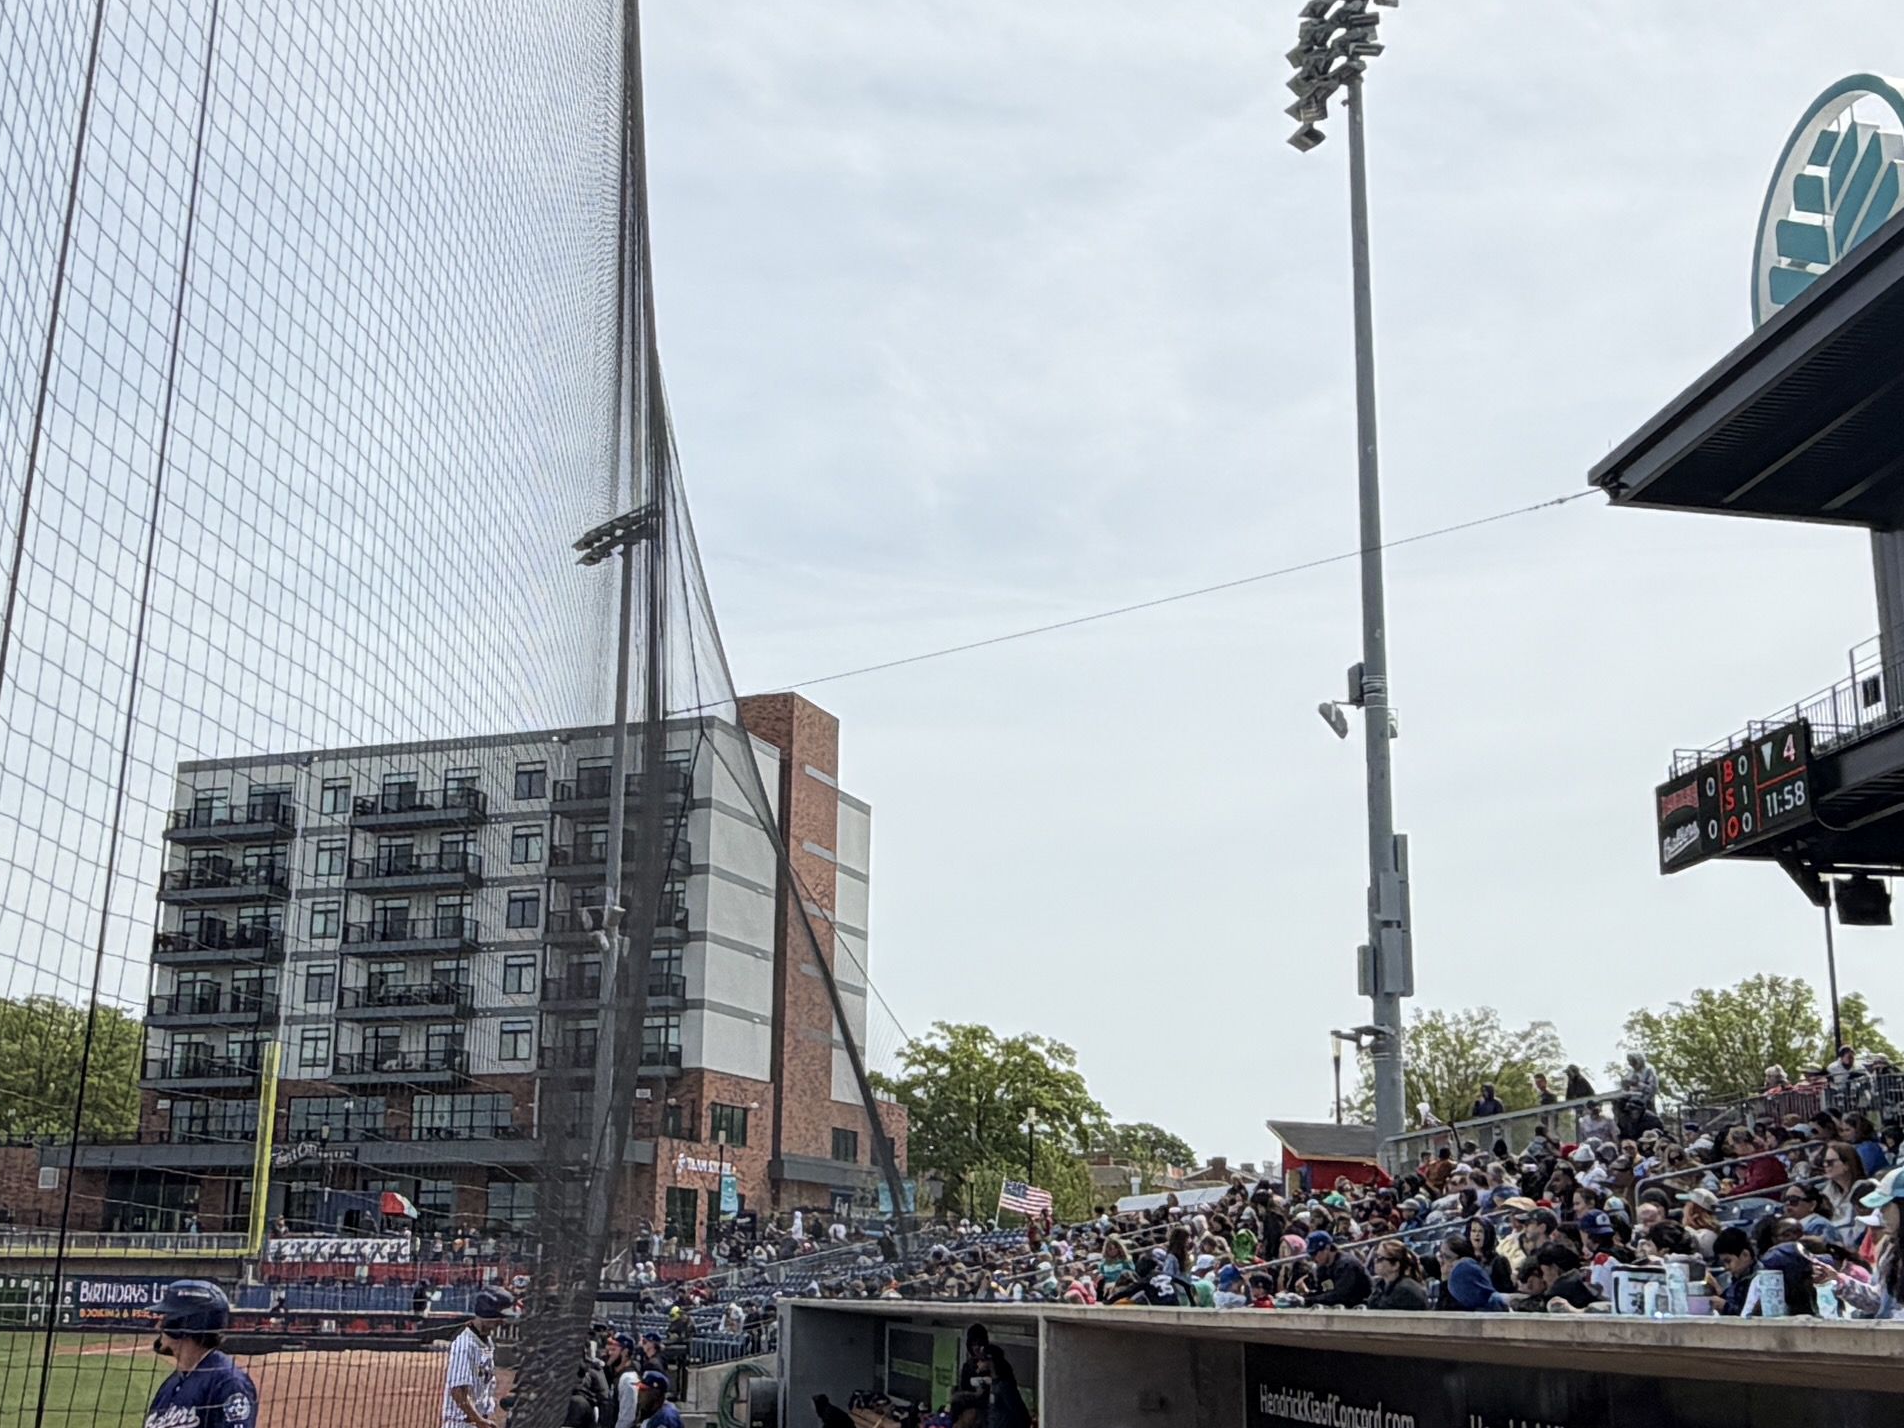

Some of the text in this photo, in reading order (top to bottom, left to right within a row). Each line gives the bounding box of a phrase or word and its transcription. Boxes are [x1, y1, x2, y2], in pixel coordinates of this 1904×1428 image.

[1782, 733, 1796, 763] 4
[1723, 755, 1748, 784] B 0
[1705, 776, 1716, 797] 0
[1725, 787, 1736, 812] S
[1742, 784, 1748, 805] 1
[1765, 780, 1806, 818] 11:58
[1708, 818, 1718, 840] 0
[1742, 811, 1752, 833] 0
